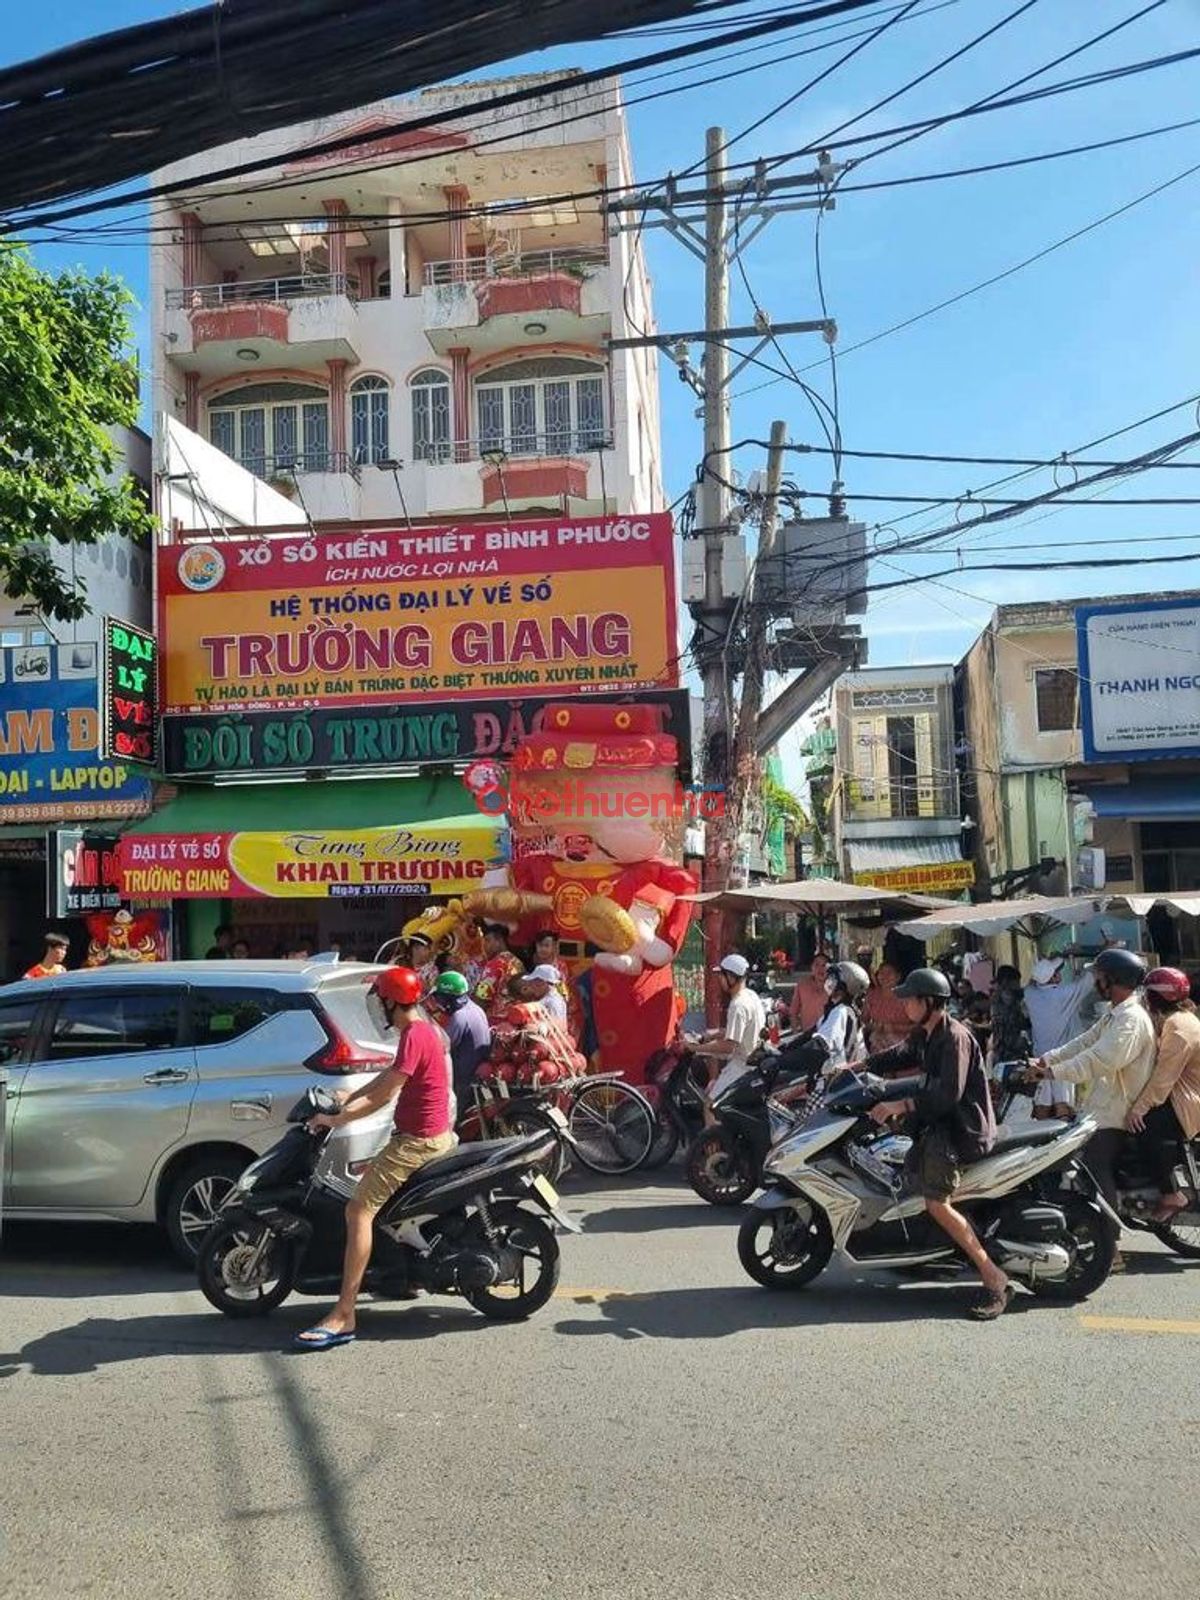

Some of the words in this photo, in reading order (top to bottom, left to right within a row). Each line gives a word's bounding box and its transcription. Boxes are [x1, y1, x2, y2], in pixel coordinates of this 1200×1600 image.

[282, 537, 317, 562] SỐ
[325, 536, 388, 560] KIẾN
[399, 528, 476, 556] THIẾT
[486, 527, 549, 550] BÌNH
[558, 520, 651, 545] PHƯỚC
[362, 562, 418, 580] NƯỚC
[422, 561, 453, 578] LỢI
[270, 595, 301, 620] HỆ
[309, 588, 391, 614] THỐNG
[399, 589, 438, 613] ĐẠI
[446, 583, 475, 607] LÝ
[482, 581, 512, 604] VÉ
[521, 575, 552, 602] SỐ
[112, 627, 153, 661] ĐẠI
[201, 616, 432, 680] TRƯỜNG
[450, 612, 631, 666] GIANG
[118, 666, 147, 692] LÝ
[276, 683, 299, 700] ĐẠI
[304, 678, 321, 695] LÝ
[324, 678, 353, 694] BÁN
[357, 676, 405, 692] TRÚNG
[410, 675, 439, 692] ĐẶC
[443, 673, 475, 689] BIỆT
[545, 665, 595, 683] XUYÊN
[1099, 678, 1160, 695] THANH
[263, 703, 314, 764] SỐ
[326, 705, 460, 762] TRÚNG
[50, 766, 127, 792] LAPTOP
[132, 844, 156, 863] ĐẠI
[160, 839, 177, 859] LÝ
[181, 838, 200, 859] VÉ
[203, 836, 222, 859] SỐ
[123, 864, 181, 892] TRƯỜNG
[185, 869, 229, 892] GIANG
[276, 862, 349, 882] KHAI
[359, 858, 486, 881] TRƯƠNG
[362, 884, 427, 896] 31/07/2024
